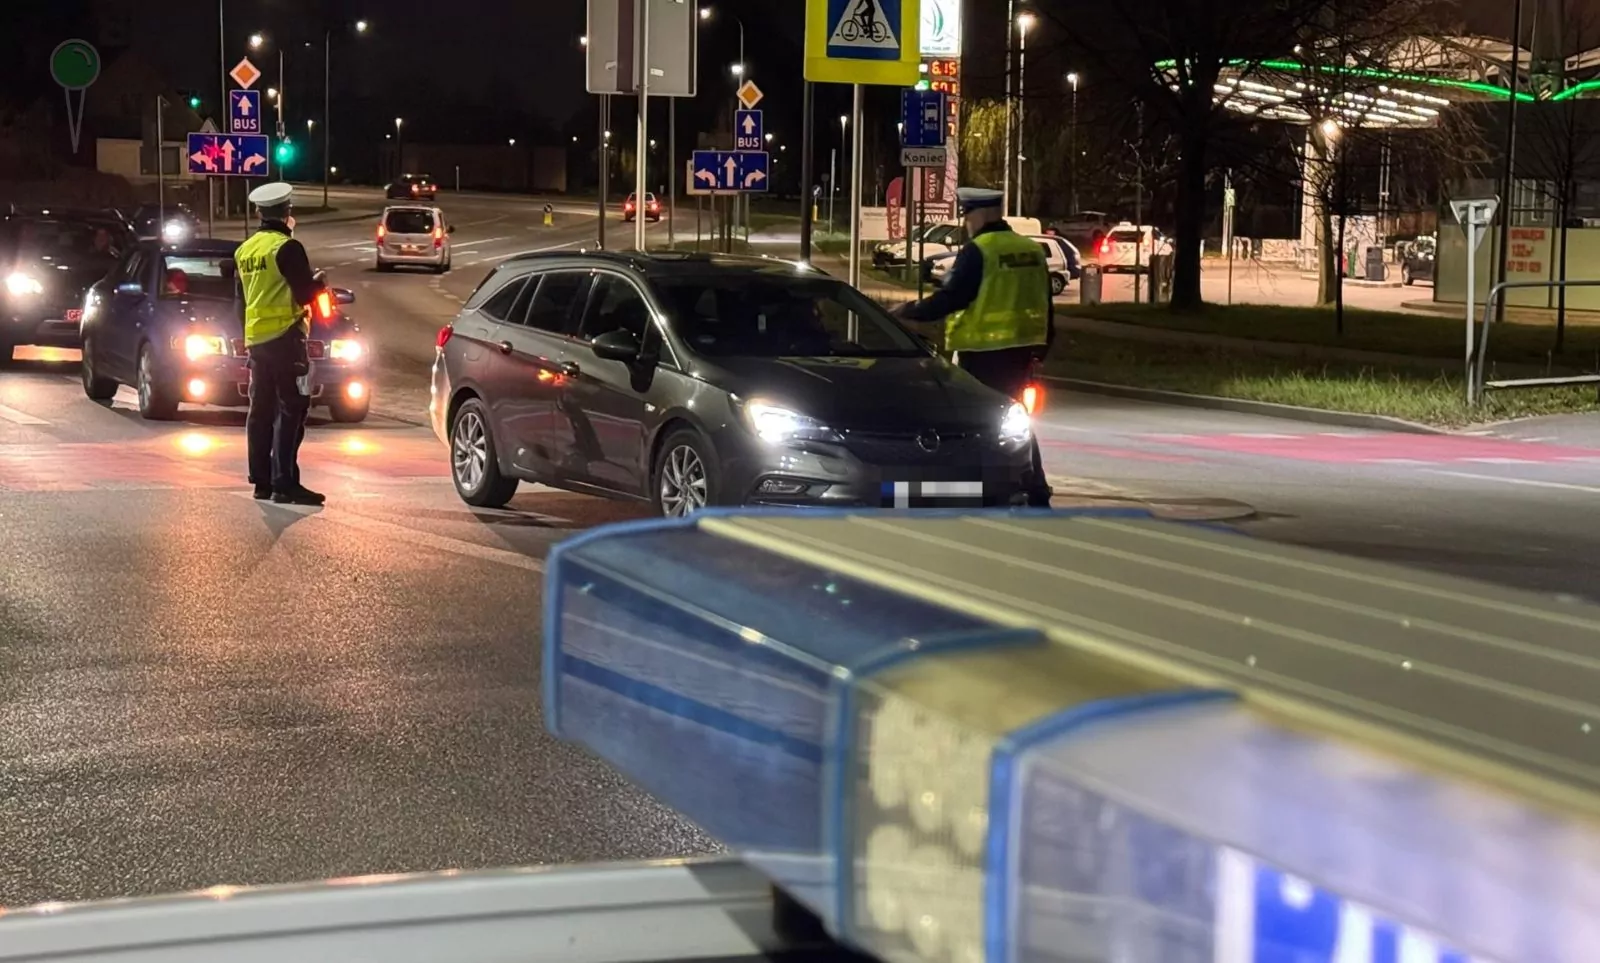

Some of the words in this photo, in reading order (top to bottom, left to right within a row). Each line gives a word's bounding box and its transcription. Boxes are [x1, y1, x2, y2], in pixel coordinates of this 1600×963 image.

[234, 119, 257, 130] BUS
[924, 122, 939, 131] BUS
[738, 137, 759, 148] BUS
[904, 152, 943, 163] Koniec
[929, 173, 937, 199] COSTA
